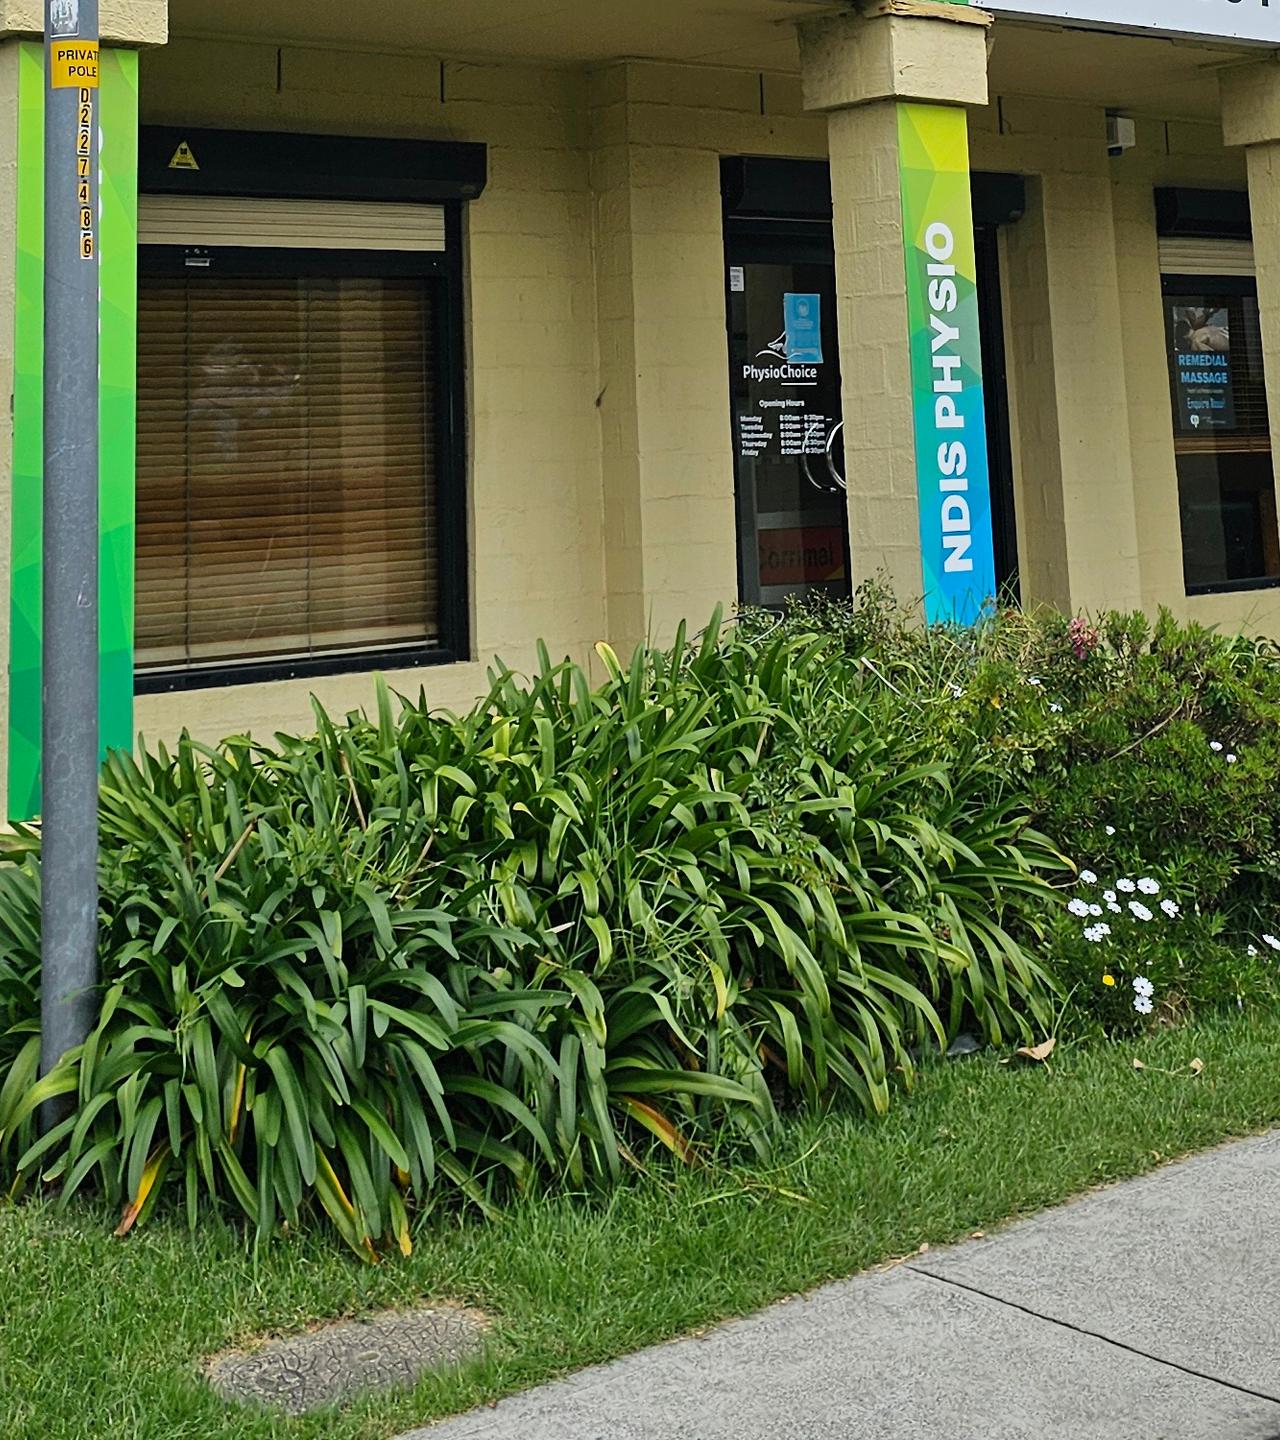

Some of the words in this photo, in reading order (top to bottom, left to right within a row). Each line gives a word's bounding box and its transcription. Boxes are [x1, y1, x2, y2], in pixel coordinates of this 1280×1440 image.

[58, 50, 99, 61] PRIVAT
[68, 66, 97, 77] POLE
[925, 221, 965, 428] PHYSIO
[1179, 355, 1227, 366] REMEDIAL
[743, 365, 817, 382] PhysioChoice
[1181, 372, 1227, 383] MASSAGE
[759, 400, 785, 408] Opening
[938, 441, 973, 574] NDIS
